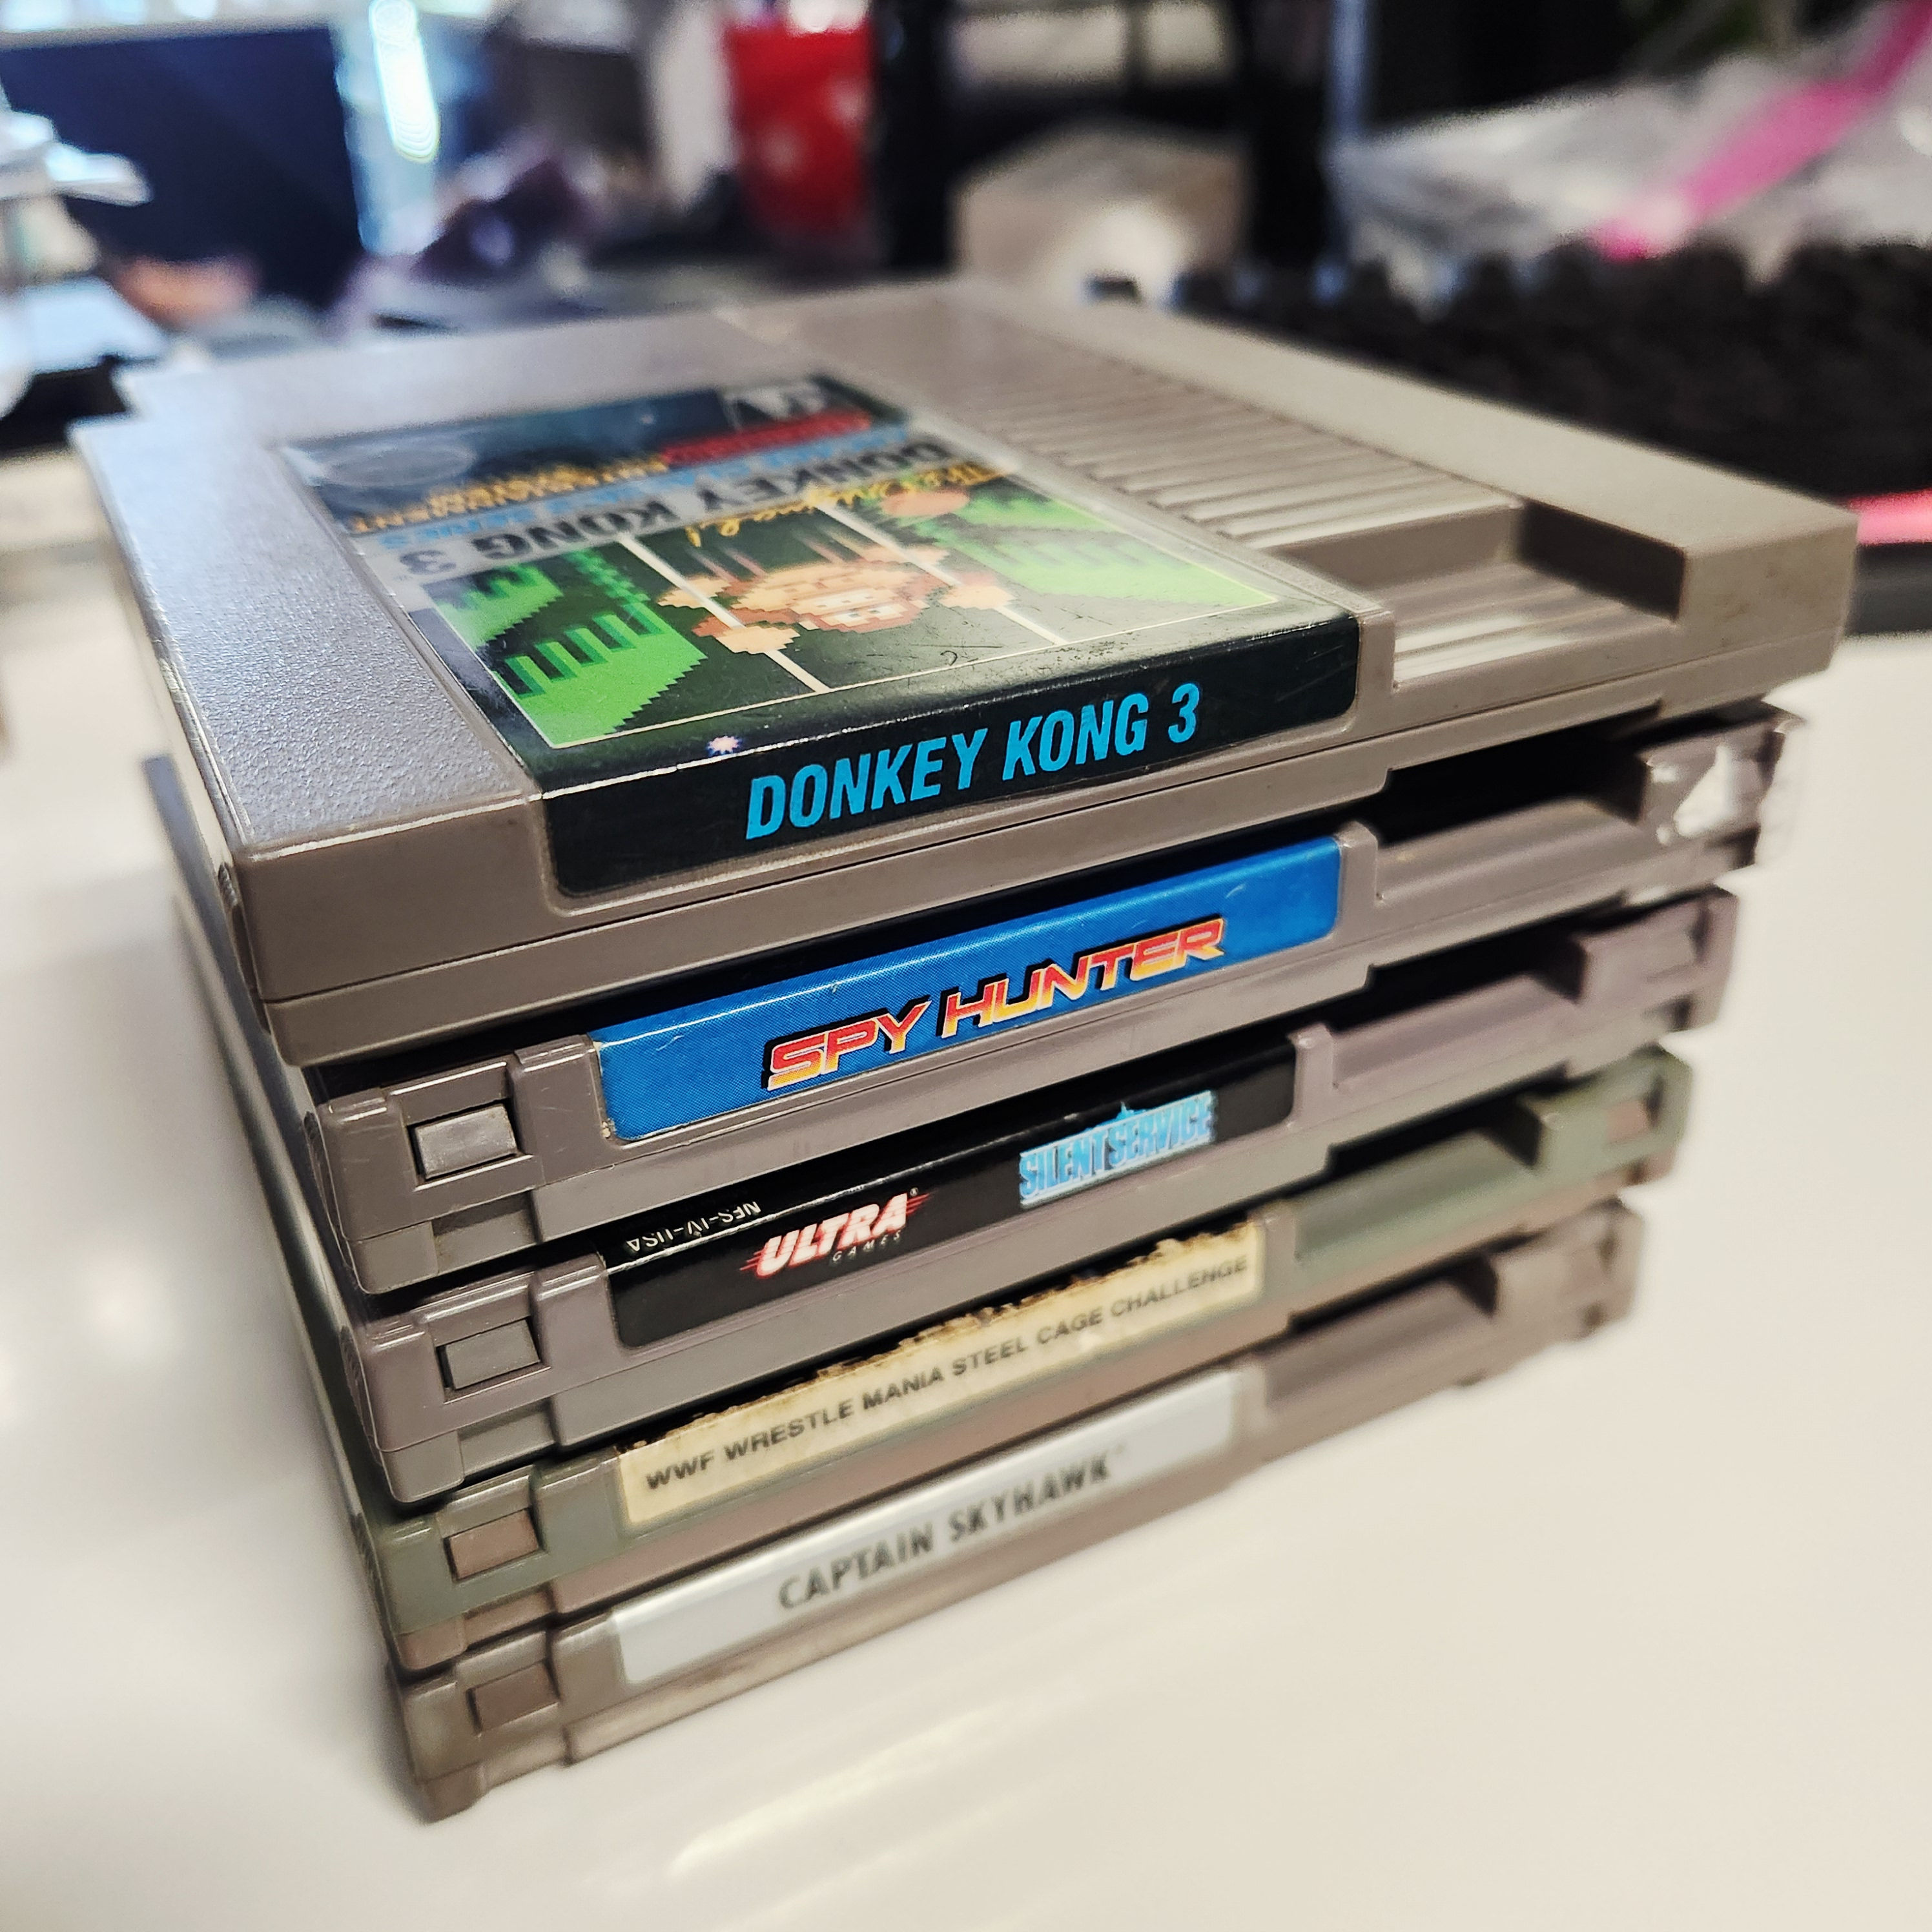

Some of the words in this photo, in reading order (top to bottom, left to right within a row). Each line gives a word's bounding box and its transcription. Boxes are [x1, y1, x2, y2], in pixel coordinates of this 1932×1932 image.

[399, 550, 457, 575] 3
[471, 498, 678, 560] KONG
[746, 727, 988, 840] DONKEY
[1002, 693, 1149, 781] KONG
[1167, 682, 1200, 744] 3
[763, 1000, 932, 1091] SPY
[938, 917, 1226, 1038] HUNTER
[1020, 1125, 1109, 1202] SILENT
[1108, 1090, 1215, 1171] SERVICE
[625, 1200, 762, 1251] NFS-IV-USA
[753, 1191, 910, 1278] ULTRA
[831, 1229, 903, 1262] GAMES
[646, 1449, 715, 1490] WWF
[723, 1397, 855, 1461] WRESTLE
[861, 1366, 944, 1410] MANIA
[952, 1334, 1029, 1377] STEEL
[1036, 1306, 1104, 1345] CAGE
[1110, 1254, 1248, 1317] CHALLENGE
[777, 1521, 934, 1610] CAPTAIN
[948, 1450, 1111, 1543] SKYHAWK
